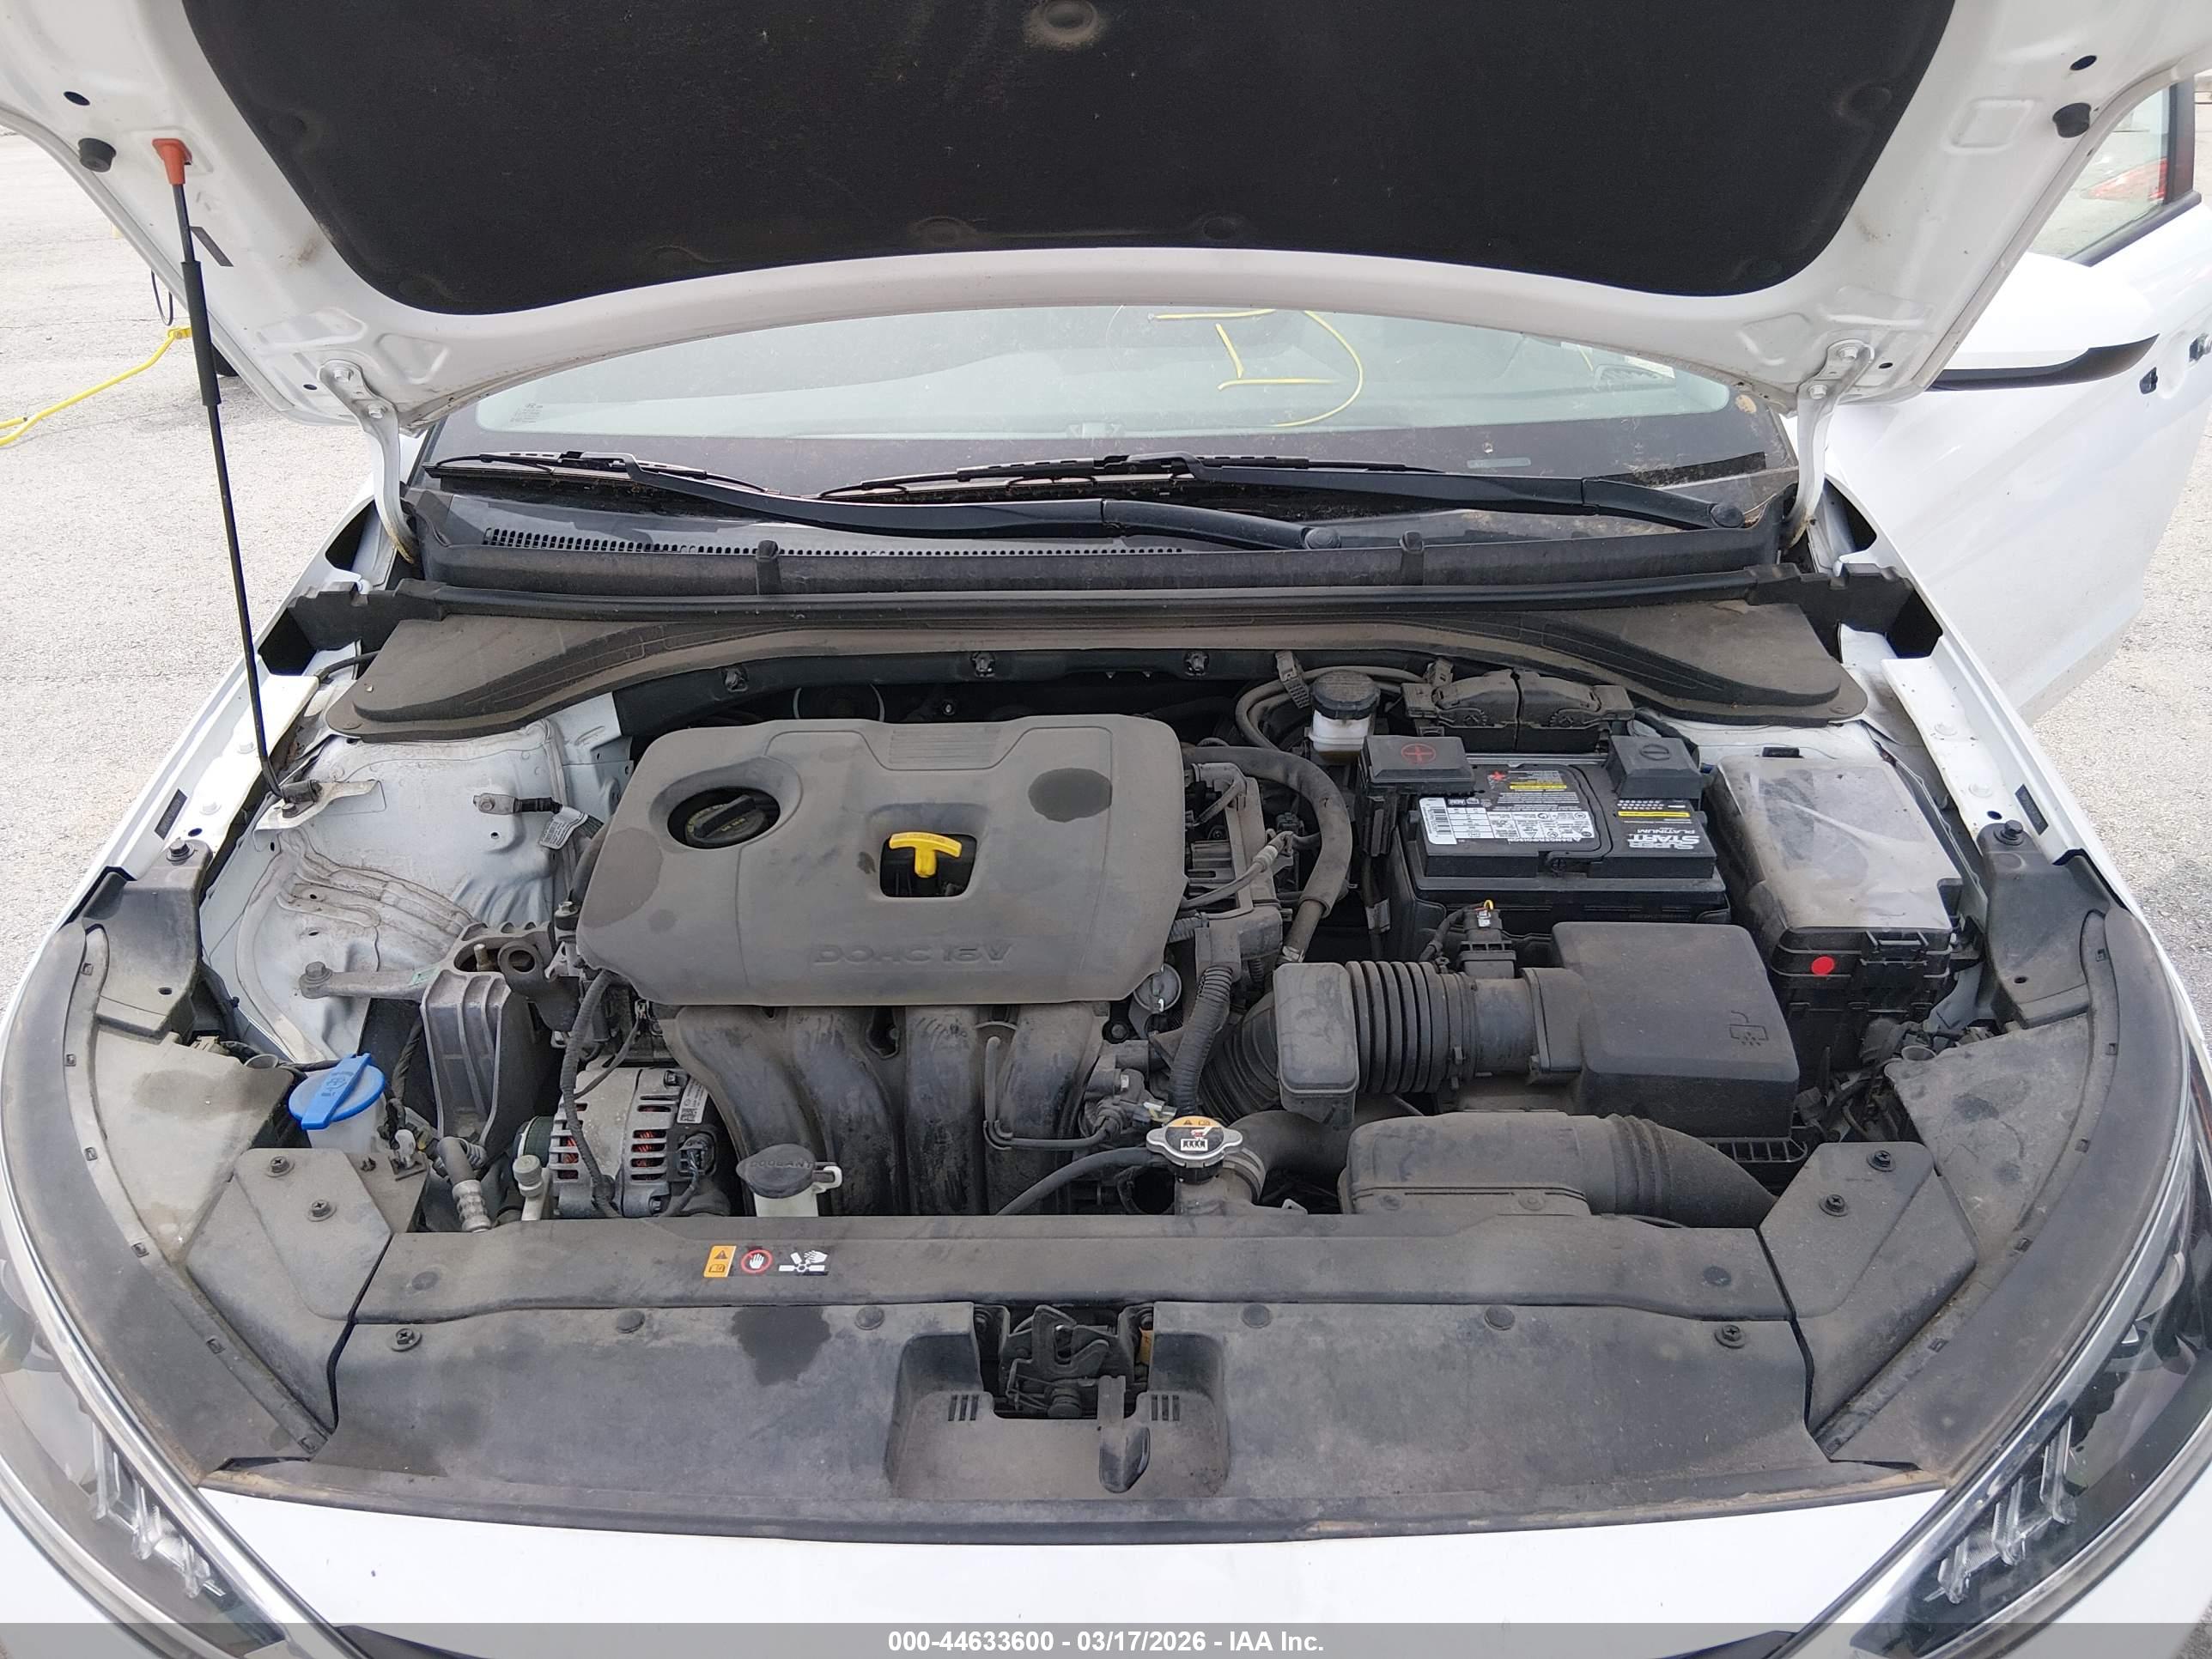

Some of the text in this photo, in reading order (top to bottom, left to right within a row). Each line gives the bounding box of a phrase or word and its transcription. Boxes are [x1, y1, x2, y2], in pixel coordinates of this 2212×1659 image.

[1627, 834, 1701, 844] START
[814, 942, 1013, 963] DOHC 16V
